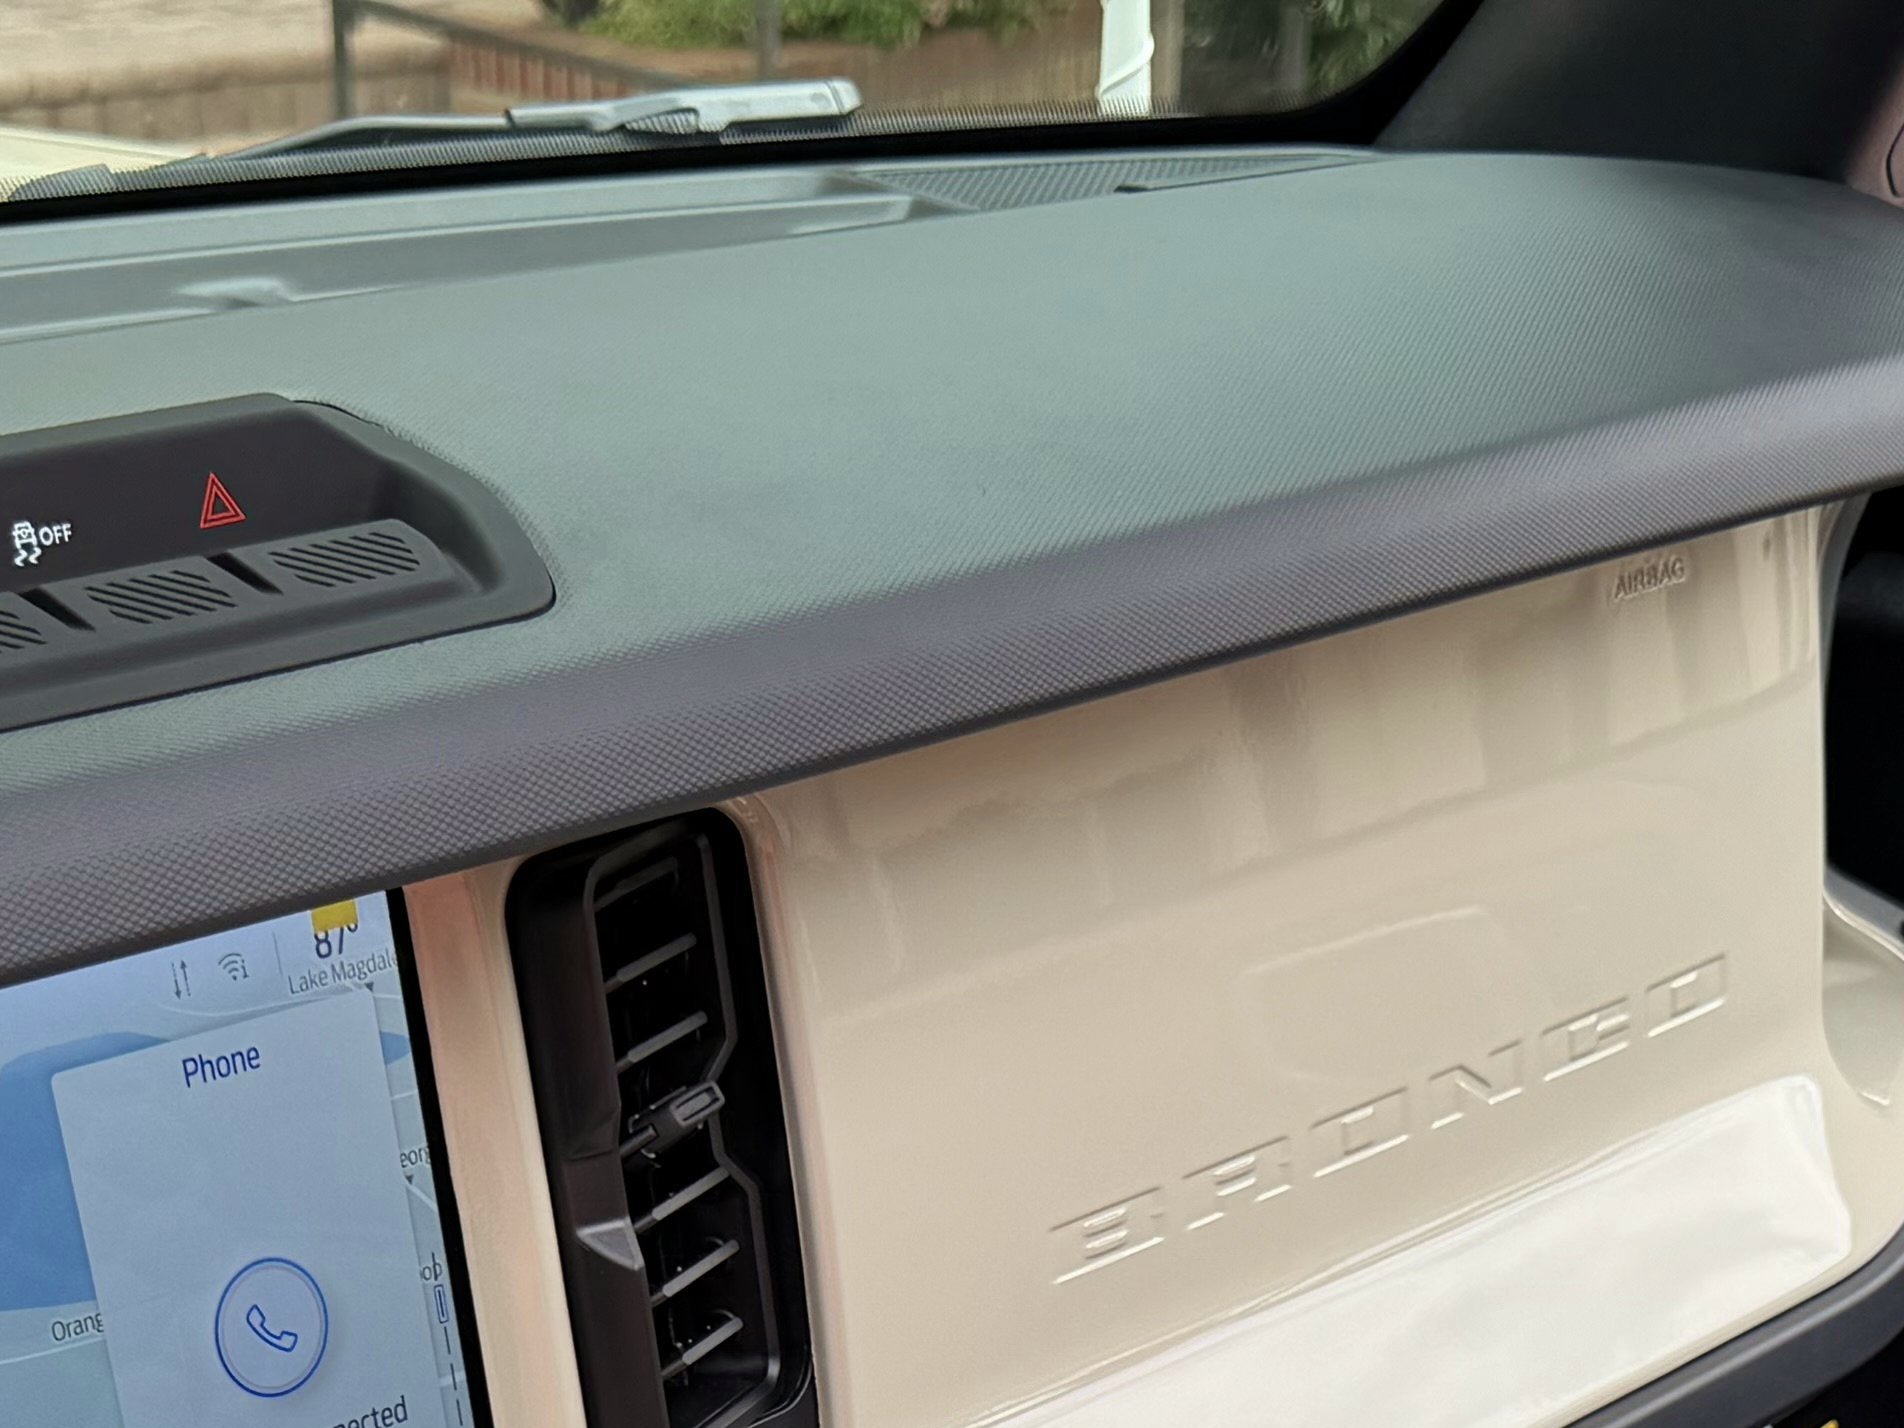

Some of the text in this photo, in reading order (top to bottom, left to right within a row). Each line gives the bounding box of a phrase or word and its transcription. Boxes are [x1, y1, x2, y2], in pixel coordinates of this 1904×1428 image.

[39, 522, 73, 547] OFF
[1614, 557, 1686, 601] AIRBAG
[288, 968, 328, 994] Lake
[182, 1044, 261, 1088] Phone
[1048, 952, 1728, 1286] BRONCO
